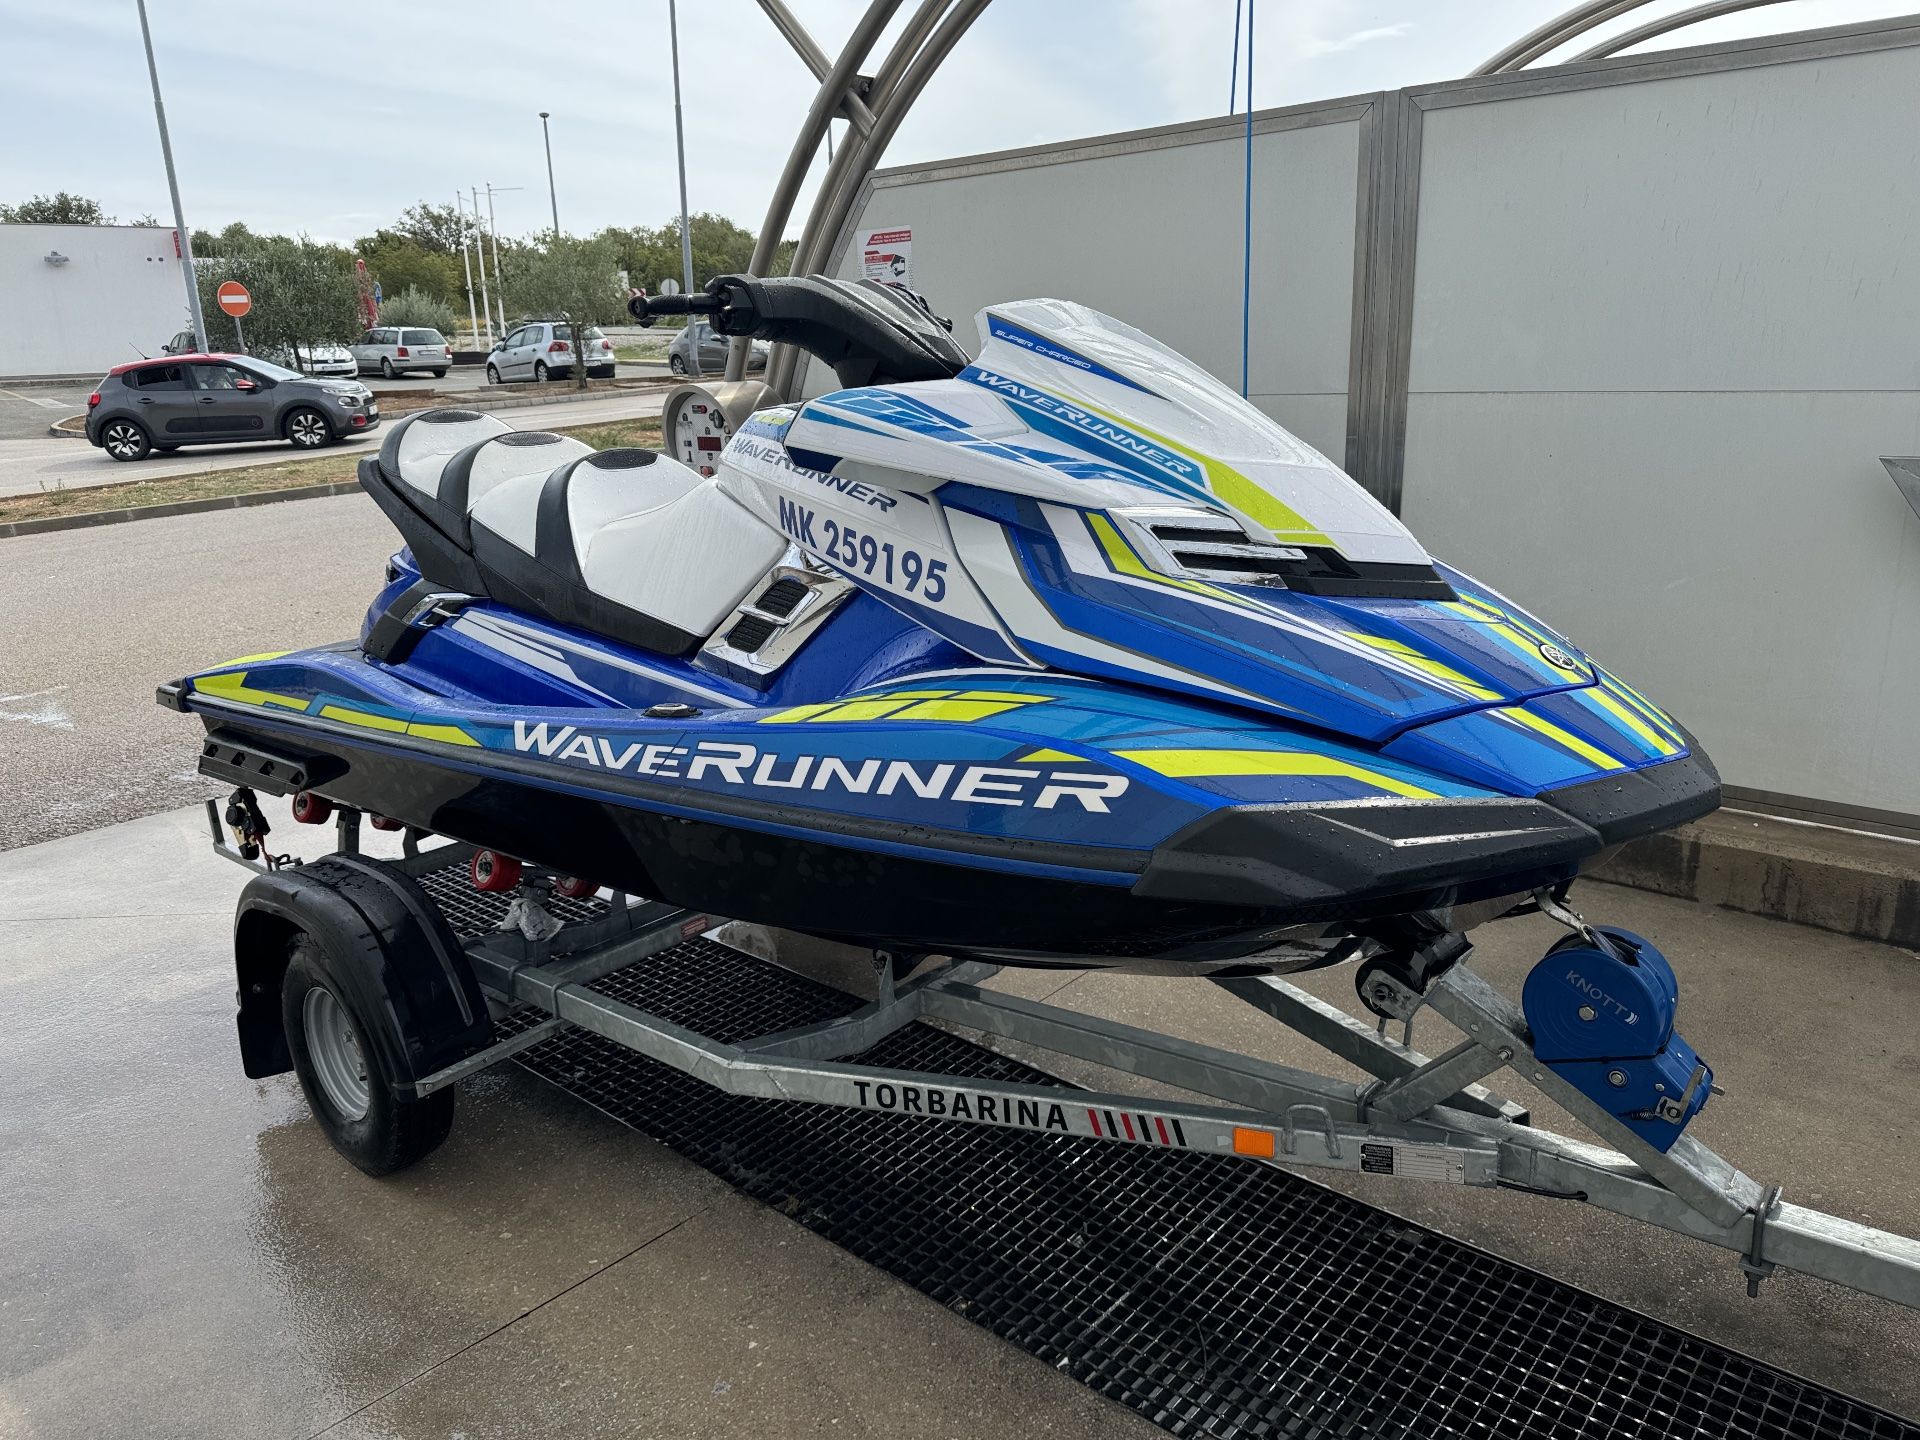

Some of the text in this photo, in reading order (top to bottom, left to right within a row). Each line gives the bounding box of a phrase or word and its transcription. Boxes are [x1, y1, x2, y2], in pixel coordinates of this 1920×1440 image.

[995, 329, 1092, 370] SUPER CHARGED
[977, 371, 1193, 476] WAVERUNNER
[778, 495, 948, 603] MK 259195
[512, 720, 1130, 814] WAVERUNNER
[1566, 970, 1629, 1015] KNOTT
[853, 1080, 1069, 1131] TORBARINA
